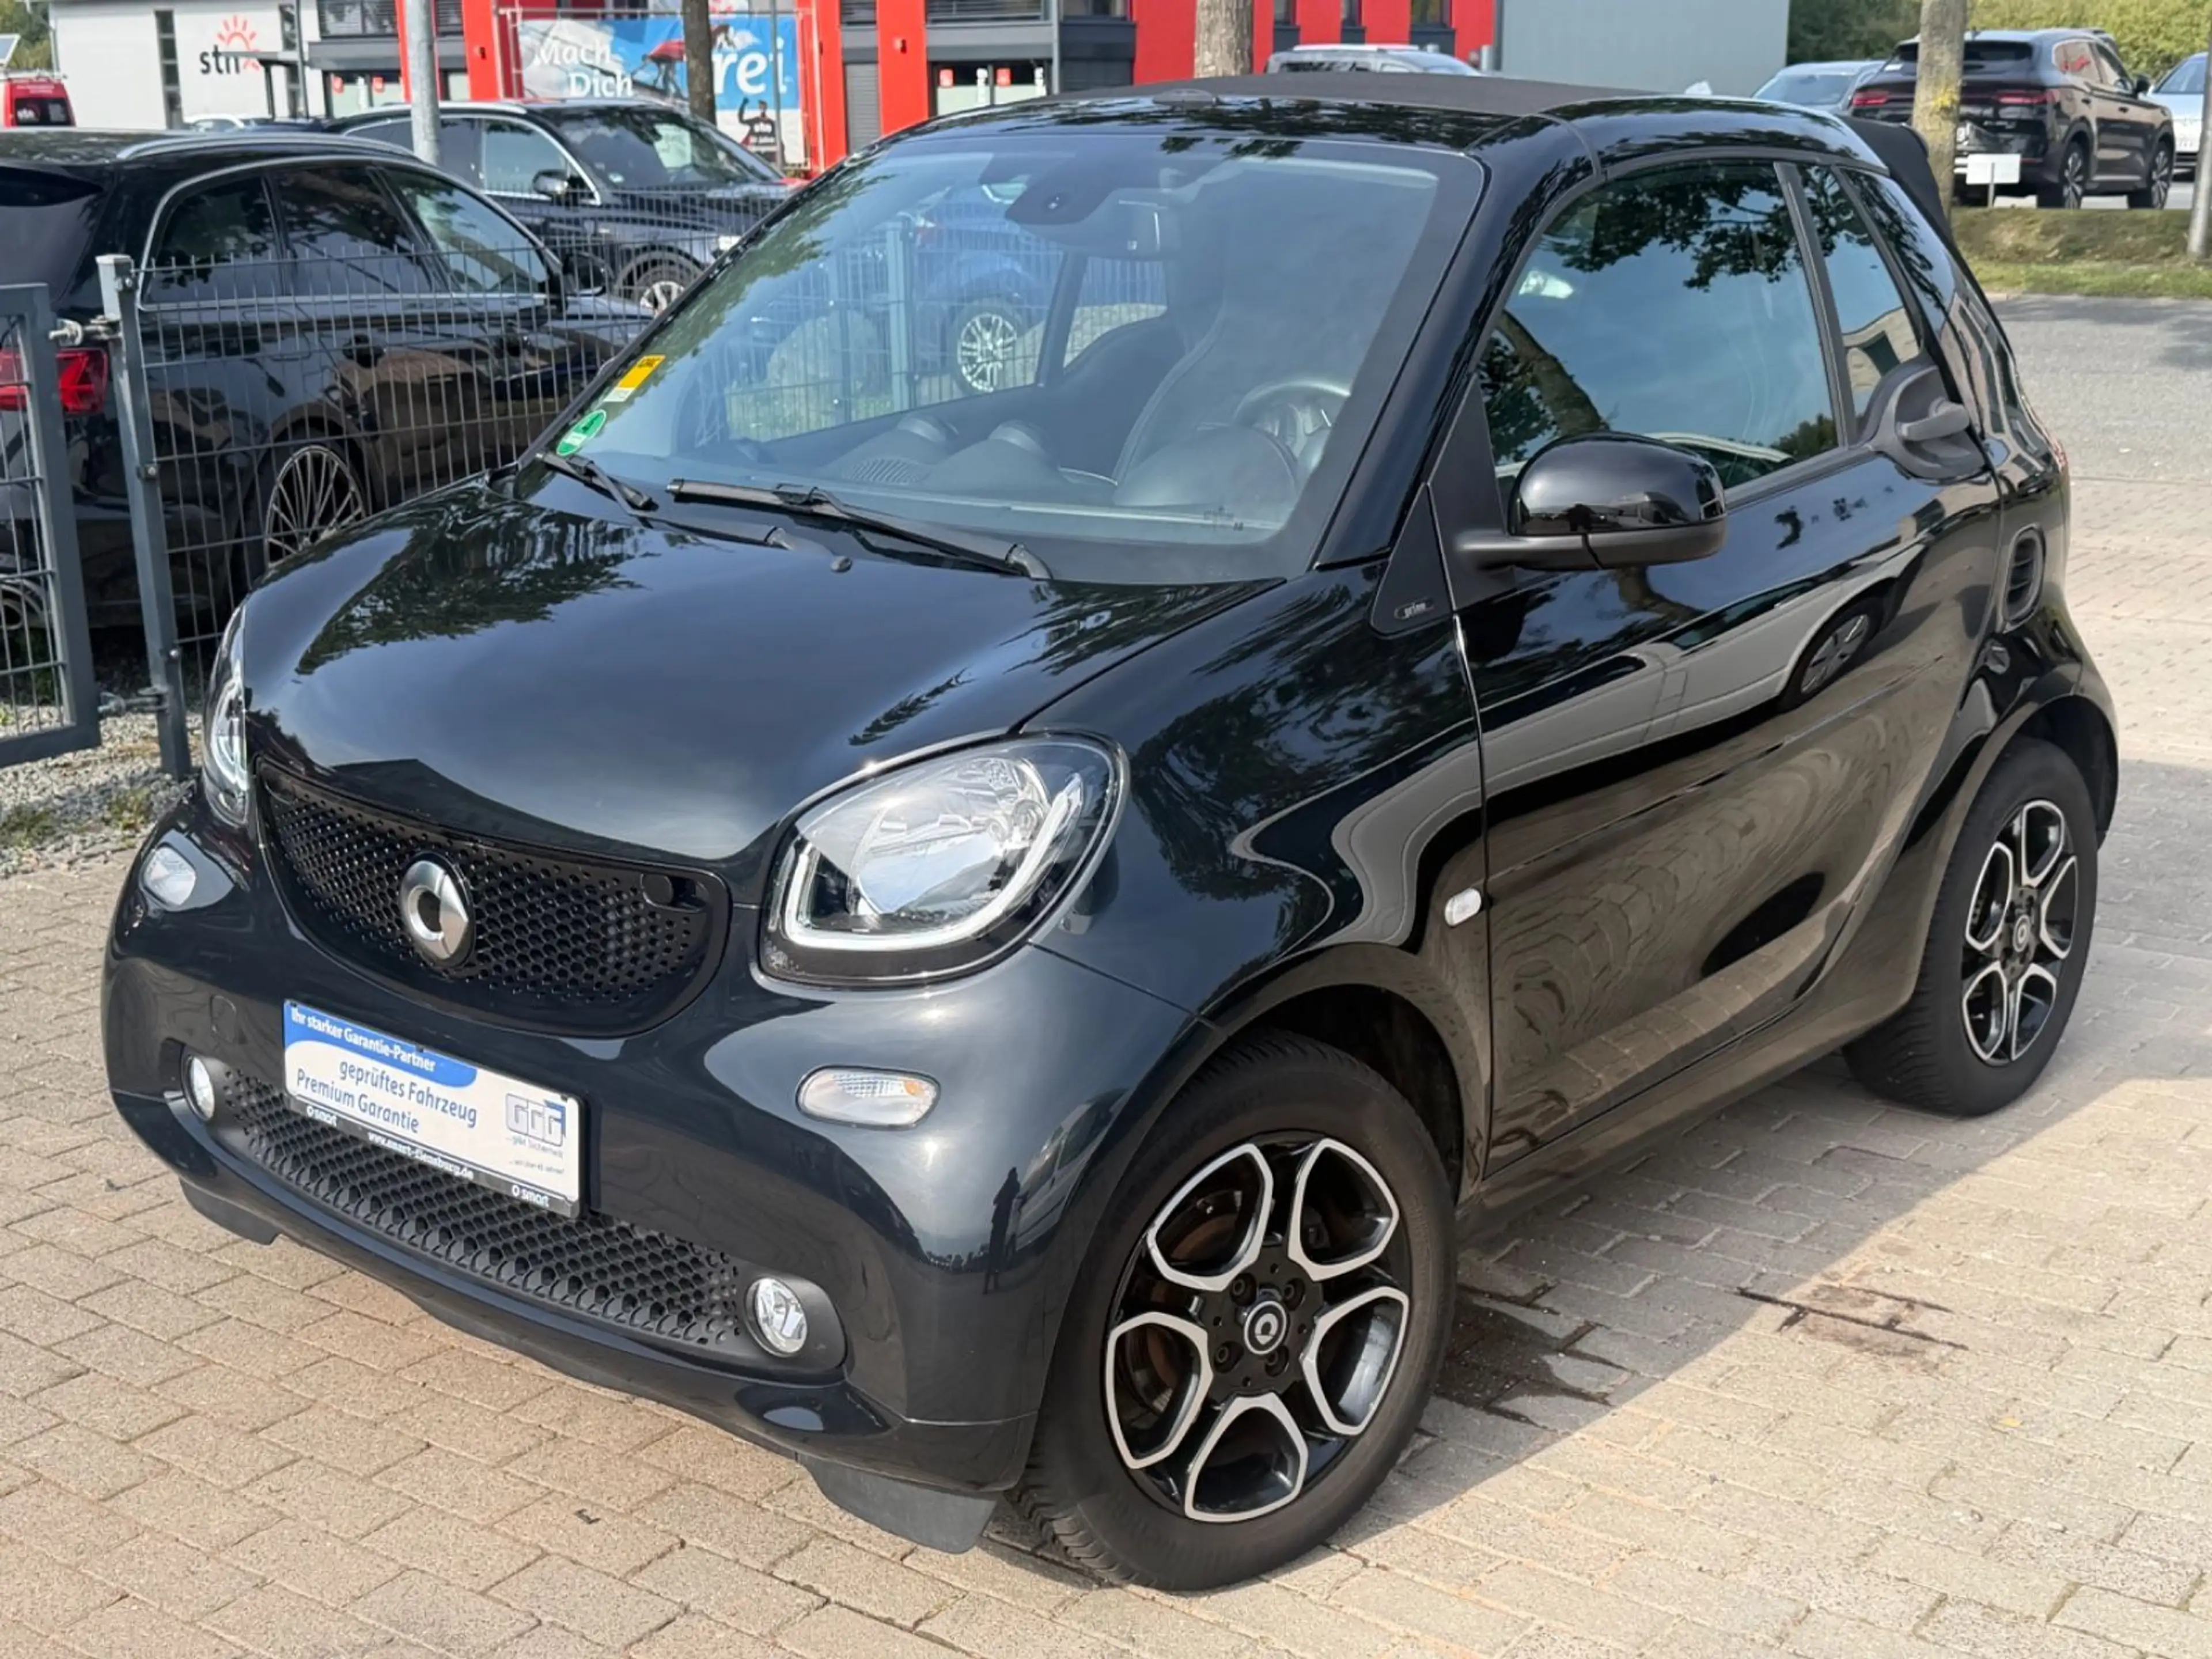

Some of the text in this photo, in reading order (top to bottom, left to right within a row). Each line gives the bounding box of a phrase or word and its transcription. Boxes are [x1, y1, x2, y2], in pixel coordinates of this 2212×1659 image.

[532, 36, 612, 66] Mach
[684, 36, 786, 94] rei
[569, 70, 634, 99] Dich
[291, 1006, 436, 1073] Ihr starker Garantie-Partner
[297, 1067, 420, 1134] Premium Garantie
[339, 1060, 478, 1128] geprüftes Fahrzeug
[520, 1188, 550, 1207] smart
